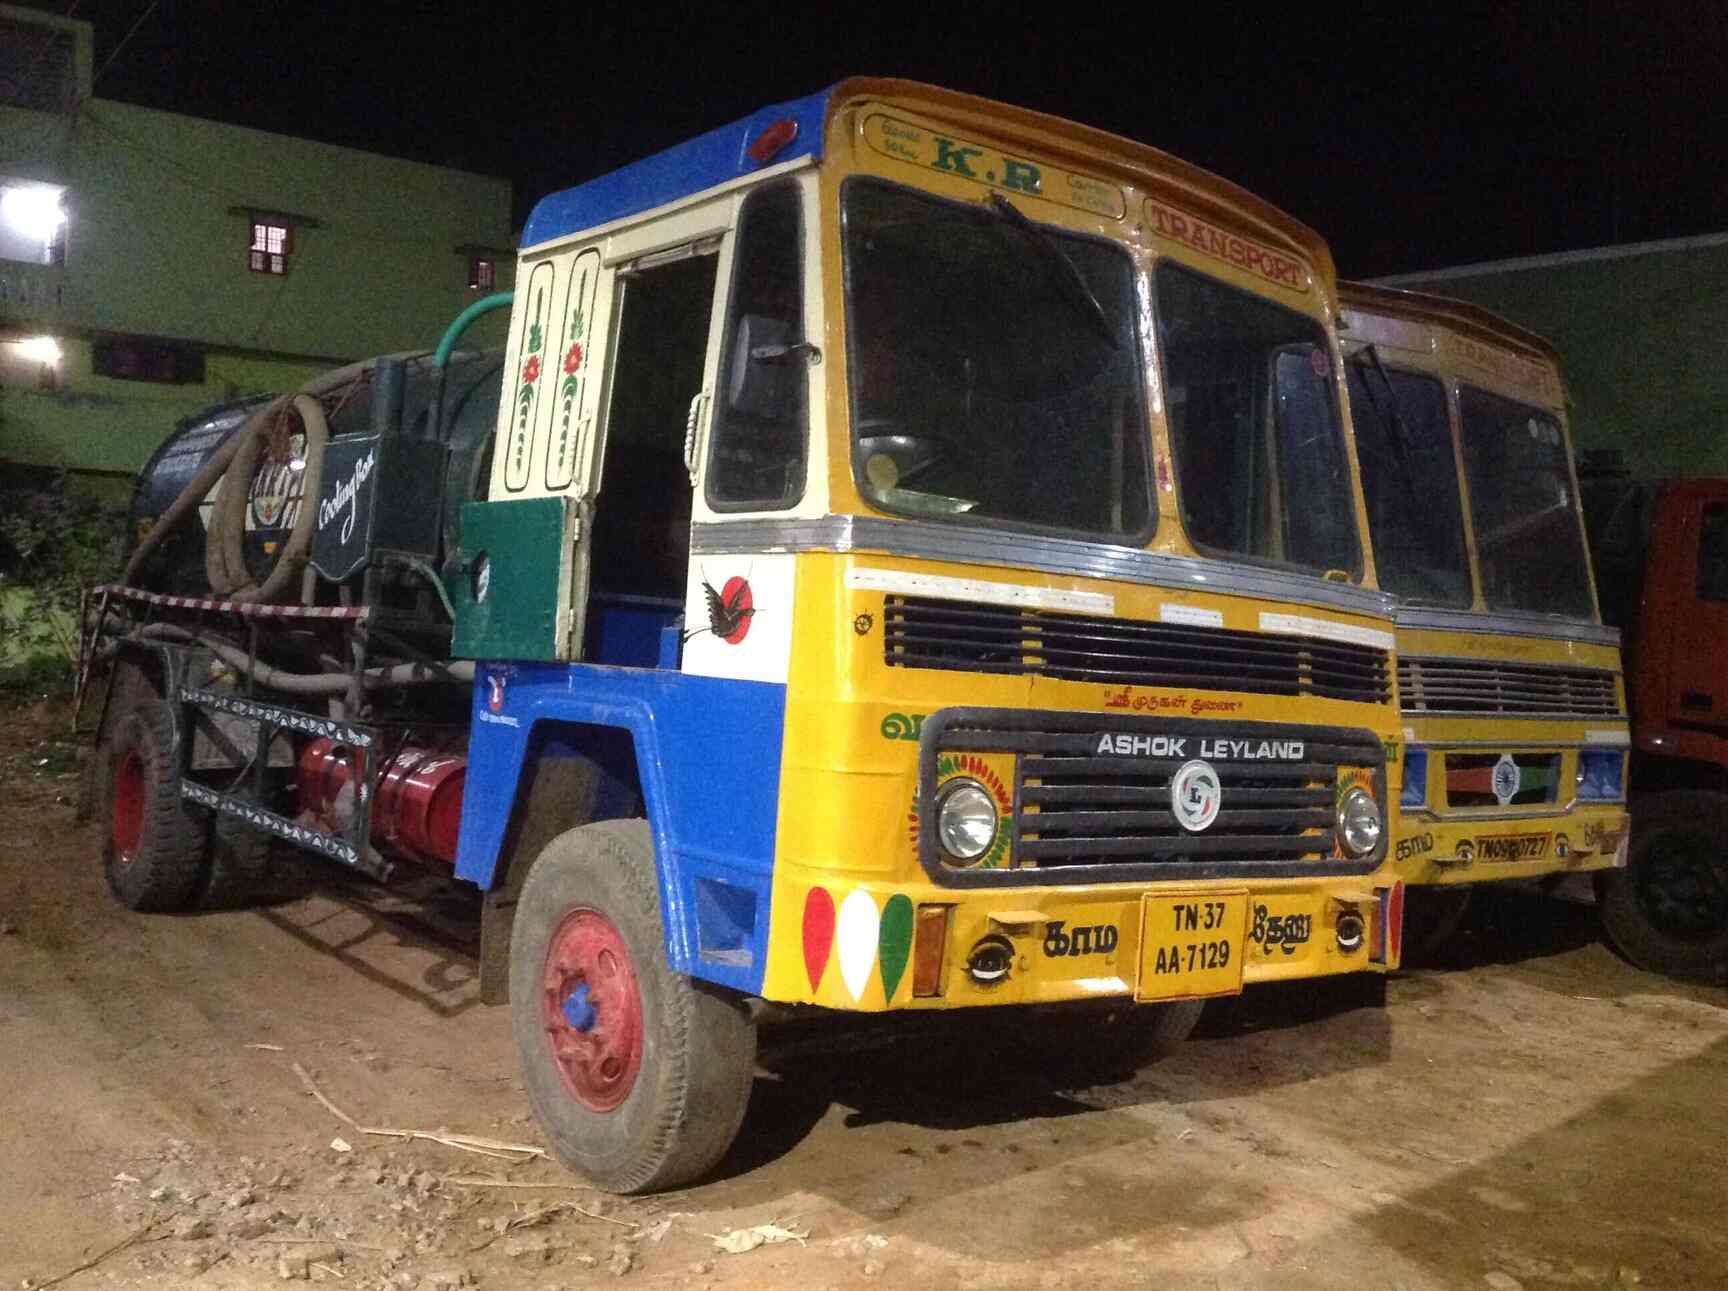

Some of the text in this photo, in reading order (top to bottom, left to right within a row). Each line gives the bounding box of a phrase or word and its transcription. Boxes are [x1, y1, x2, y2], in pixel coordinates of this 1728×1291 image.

[1151, 205, 1302, 285] TRANSPORT
[1097, 733, 1304, 760] ASHOK LEYLAND
[1043, 921, 1118, 957] காம
